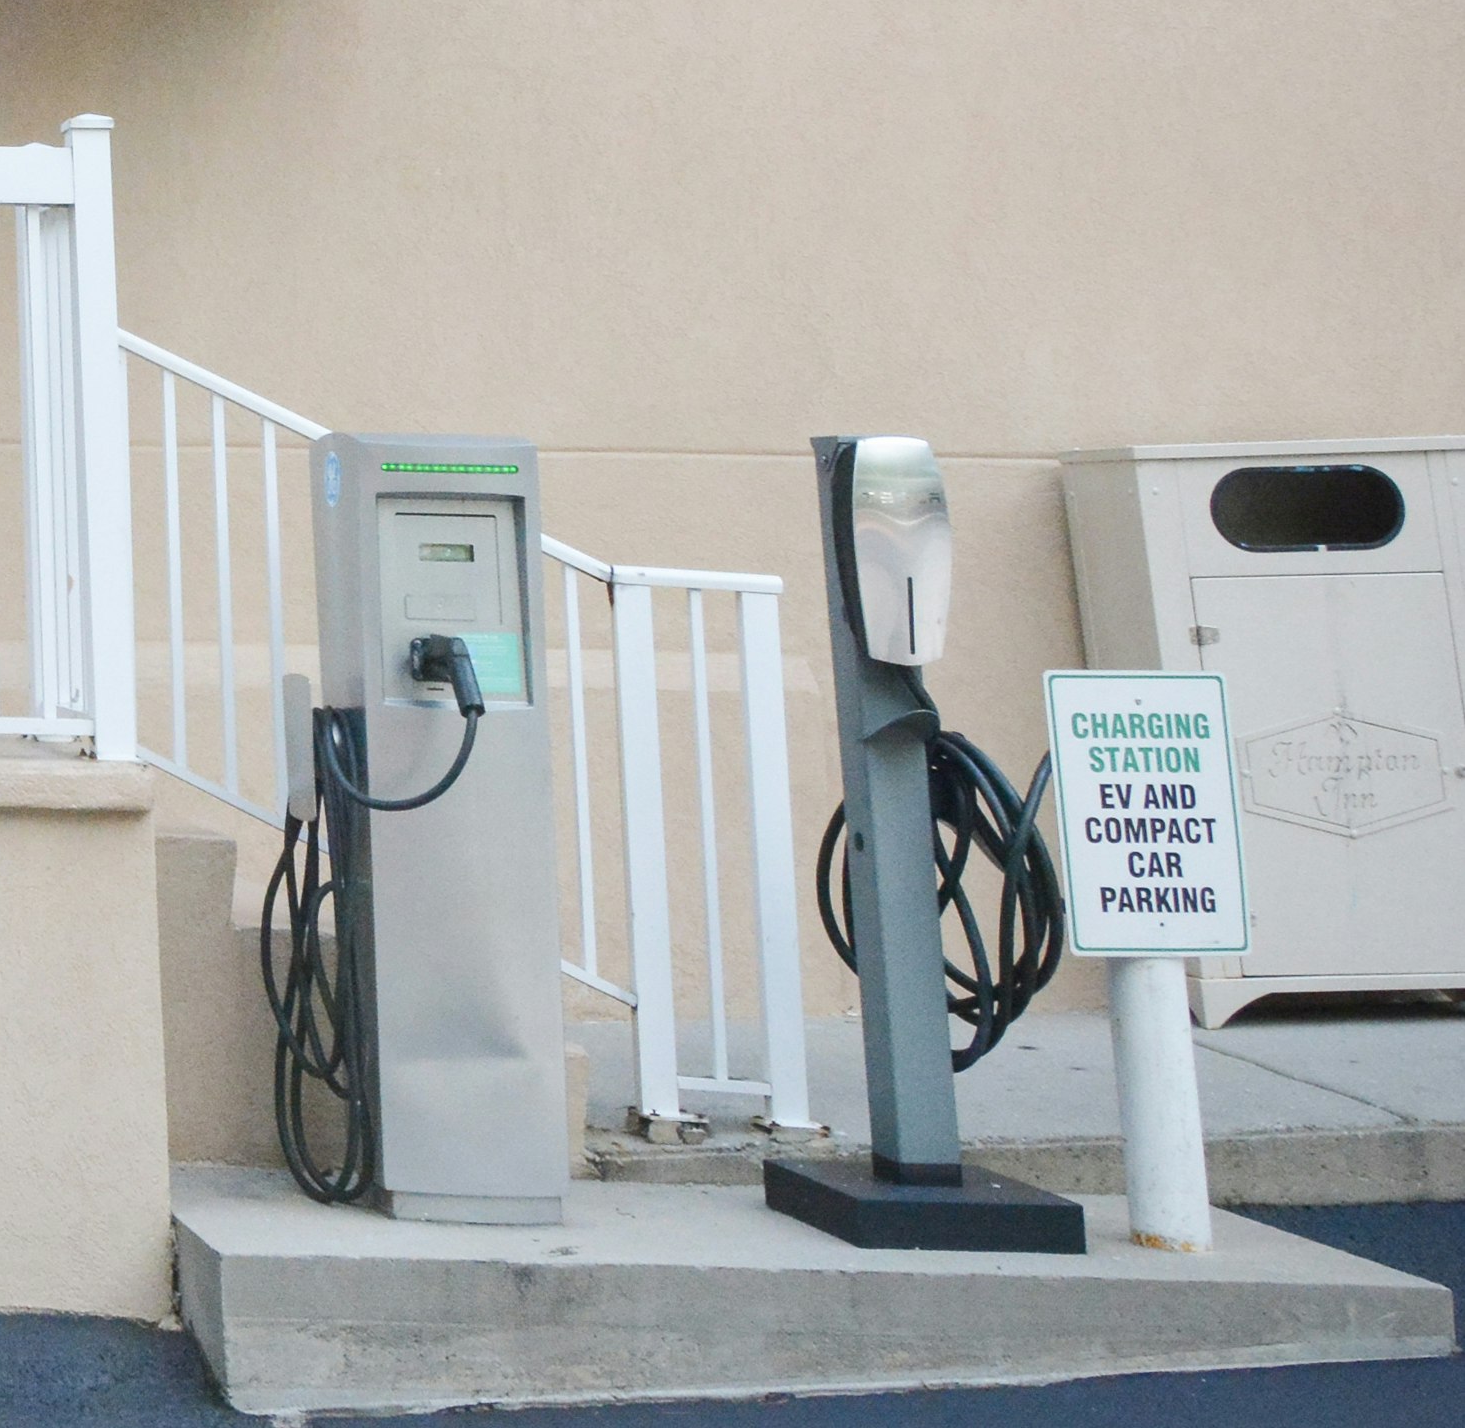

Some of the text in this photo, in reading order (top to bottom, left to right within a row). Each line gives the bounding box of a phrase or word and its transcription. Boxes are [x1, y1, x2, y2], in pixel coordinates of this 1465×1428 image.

[1071, 712, 1210, 739] CHARGING
[1089, 747, 1200, 772] STATION
[1100, 784, 1196, 809] EV AND
[1085, 818, 1216, 844] COMPACT
[1128, 852, 1183, 878] CAR
[1100, 887, 1217, 912] PARKING
